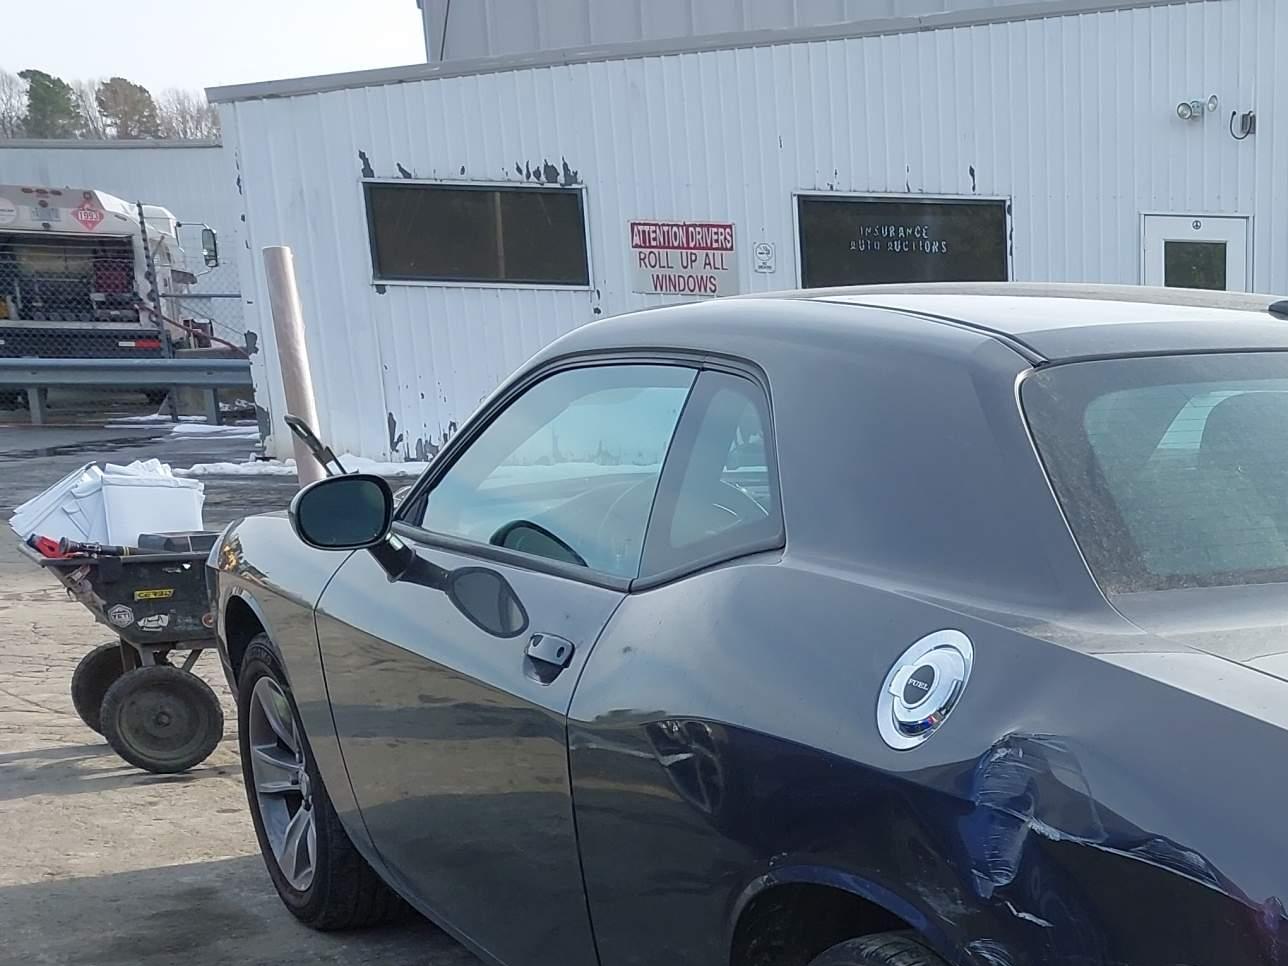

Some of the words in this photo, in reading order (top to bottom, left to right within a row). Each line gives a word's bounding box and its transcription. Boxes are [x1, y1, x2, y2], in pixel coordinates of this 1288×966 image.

[79, 211, 98, 221] 1993
[632, 224, 687, 248] ATTENTION
[688, 226, 732, 249] DRIVERS
[860, 225, 929, 239] INSURANCE
[638, 250, 674, 269] ROLL
[680, 251, 698, 270] UP
[703, 252, 729, 271] ALL
[651, 273, 718, 294] WINDOWS
[908, 678, 929, 691] FUEL
